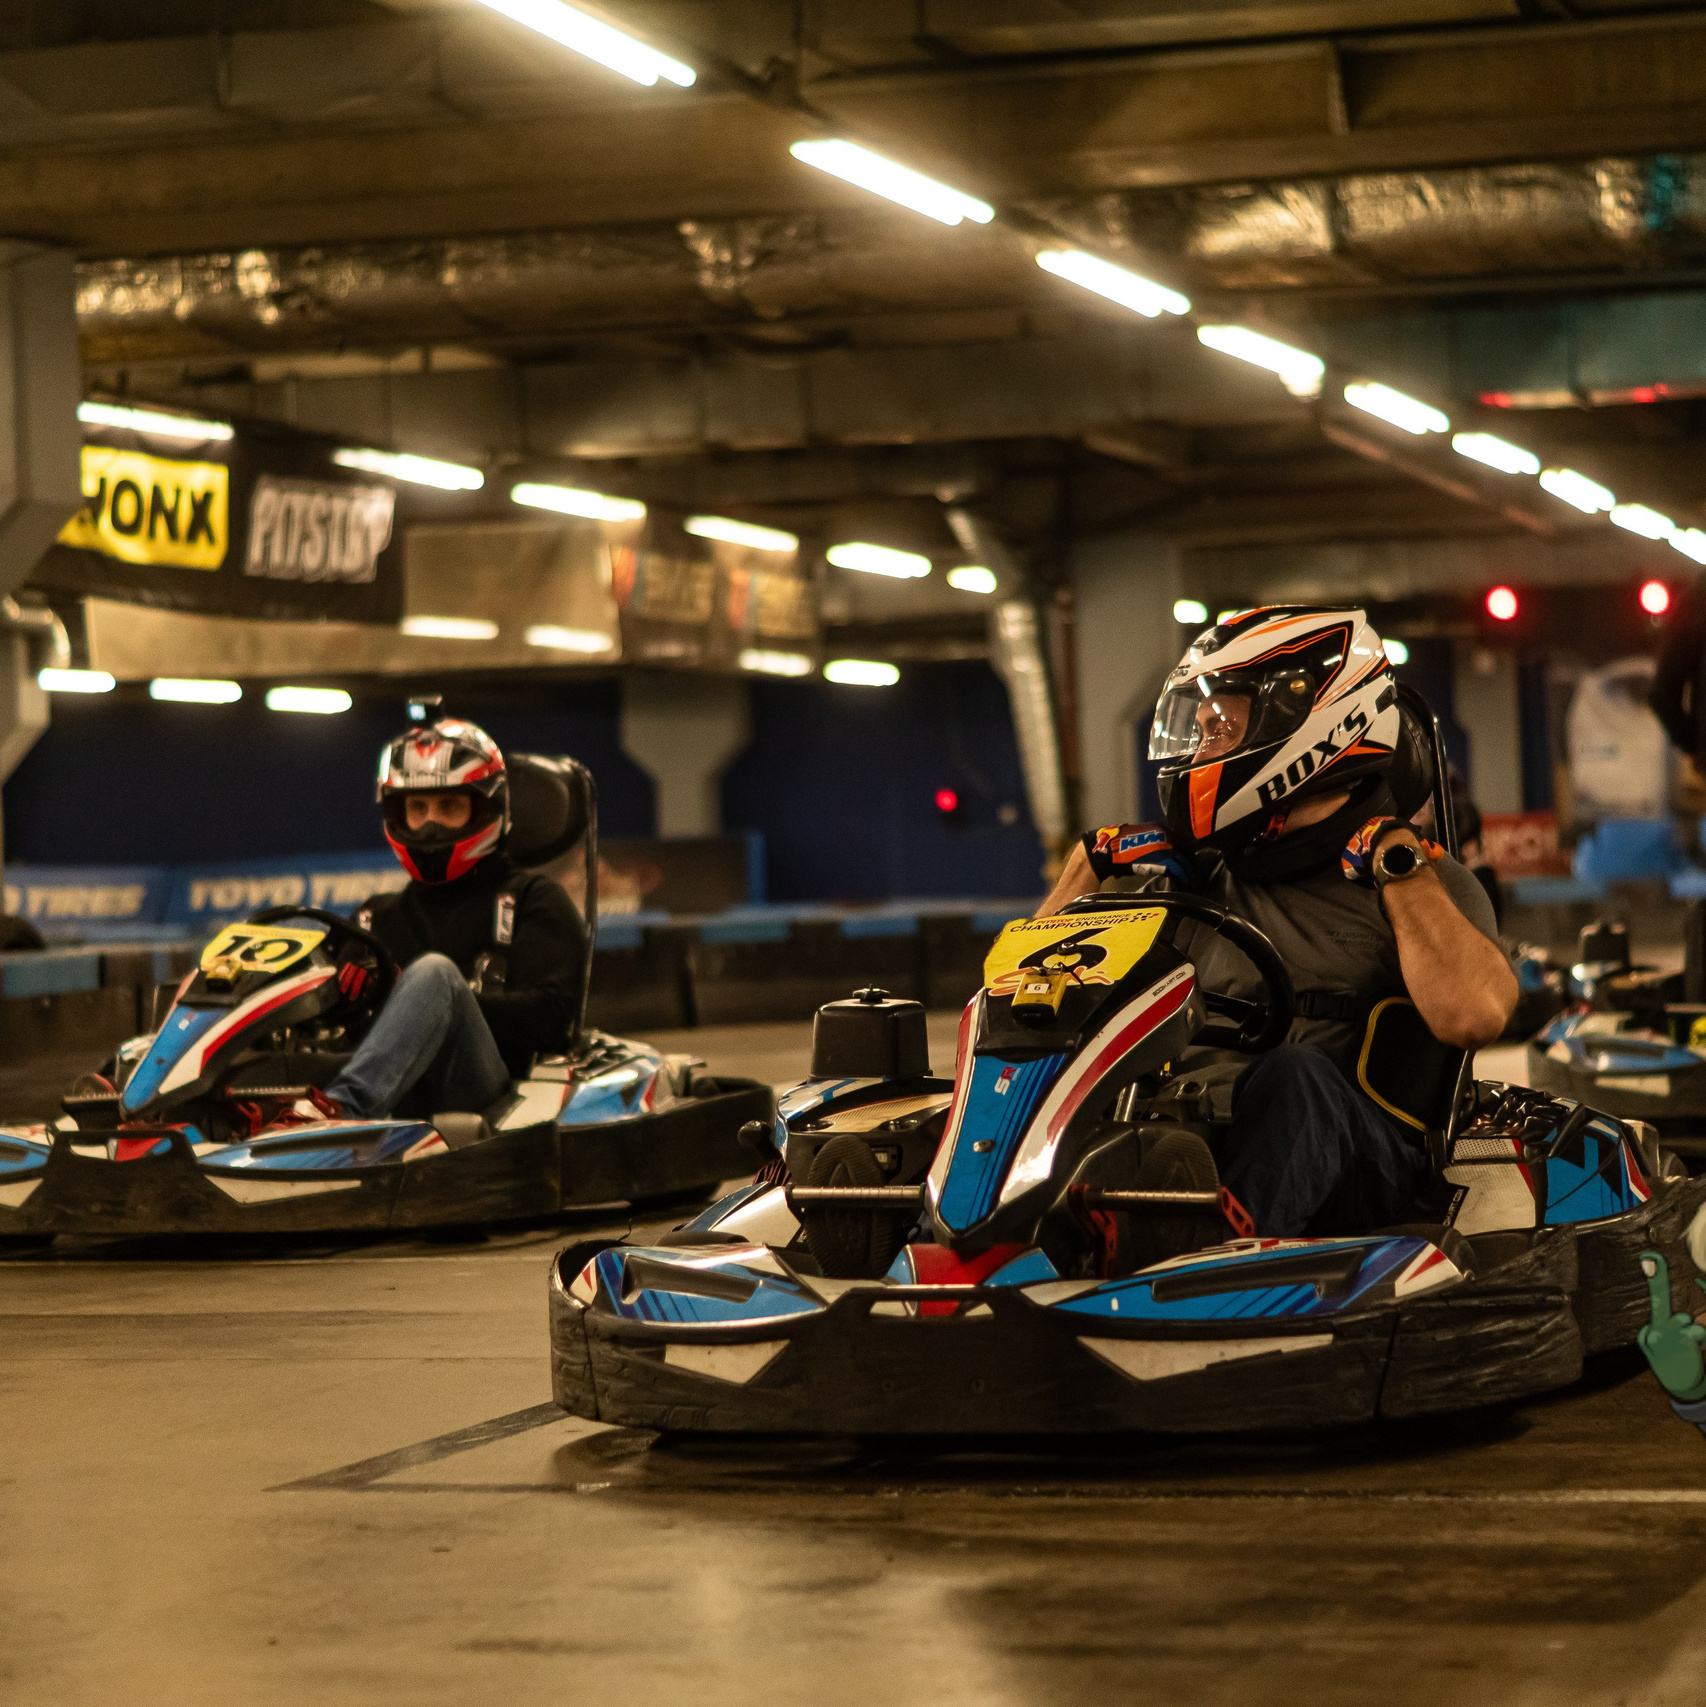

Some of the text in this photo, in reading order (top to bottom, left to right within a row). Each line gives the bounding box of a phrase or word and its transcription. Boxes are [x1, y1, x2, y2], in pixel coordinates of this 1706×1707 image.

[1254, 702, 1368, 807] BOX'S
[1120, 830, 1166, 853] KTM
[1010, 917, 1129, 933] CHAMPIONSHIP
[1036, 912, 1132, 925] PITSTOP ENDURANCE
[215, 934, 304, 964] 10
[1018, 927, 1113, 970] 6
